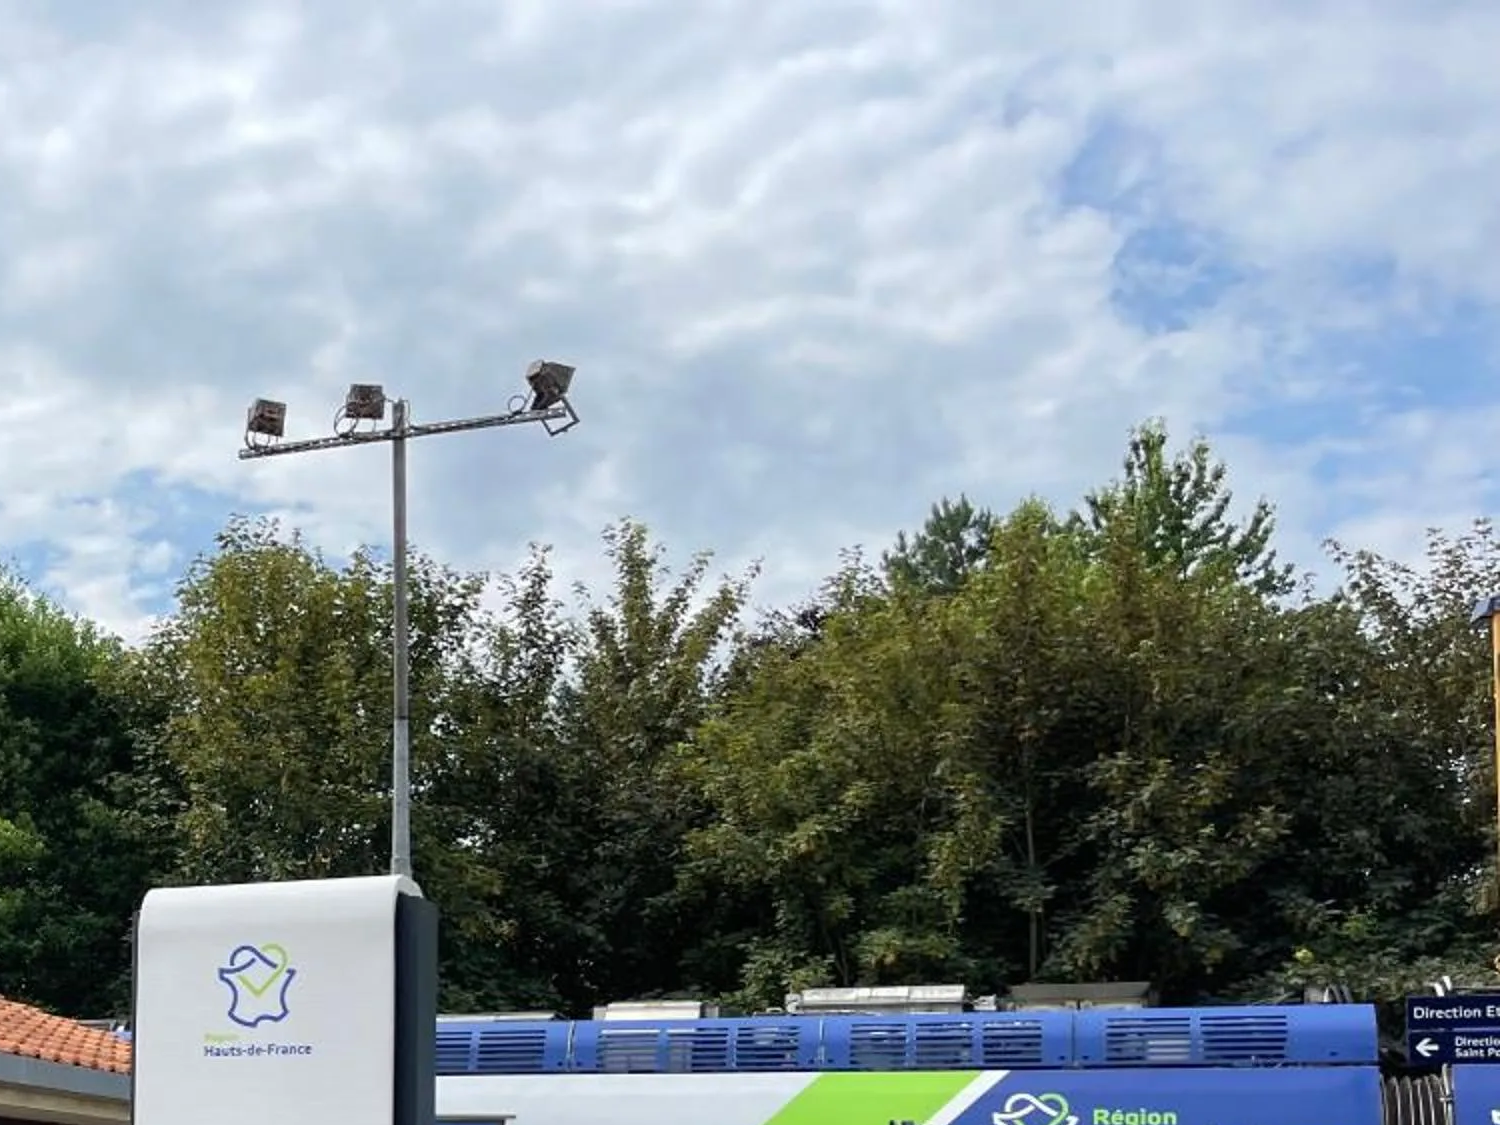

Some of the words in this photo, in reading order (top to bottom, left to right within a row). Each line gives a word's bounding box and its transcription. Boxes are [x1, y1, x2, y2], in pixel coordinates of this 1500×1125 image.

[1413, 1006, 1482, 1019] Direction
[203, 1044, 312, 1056] Hauts-de-France
[1455, 1047, 1485, 1058] Saint
